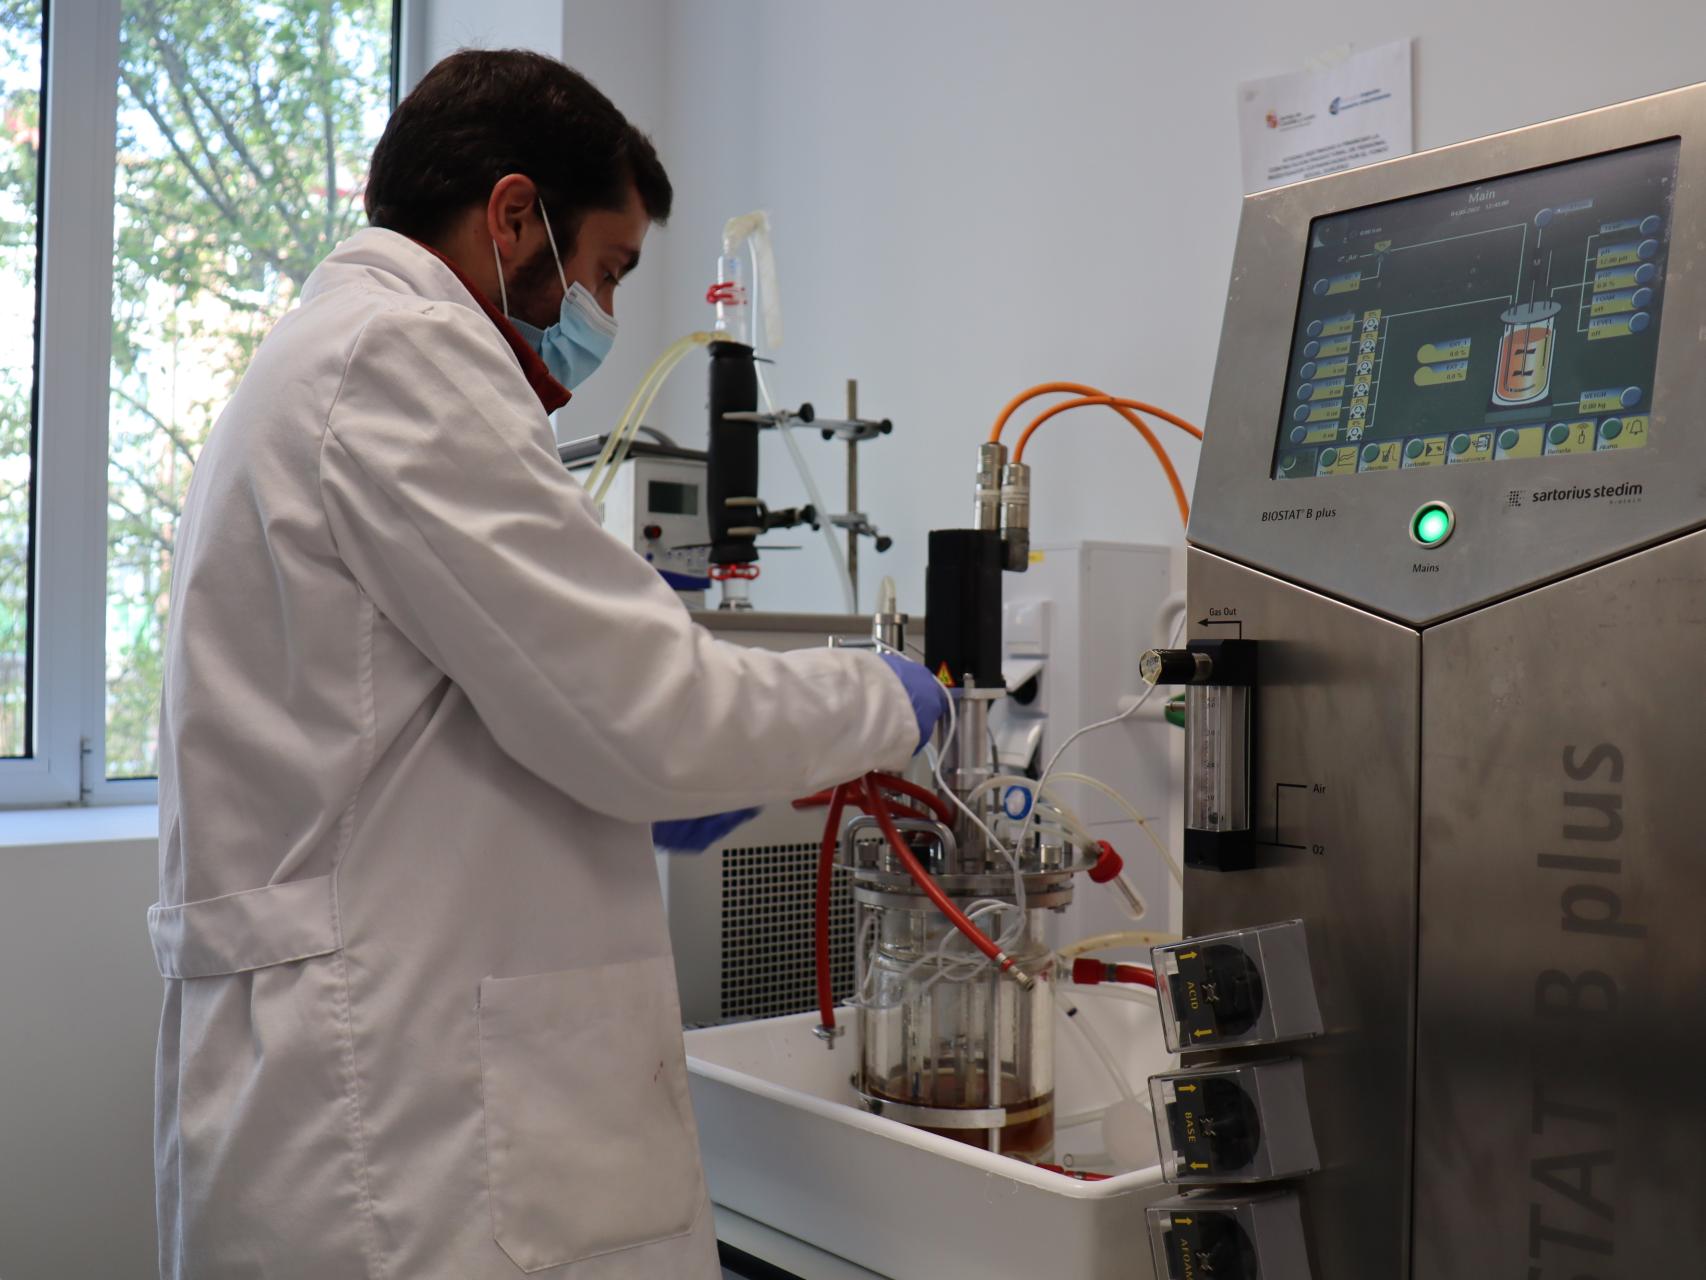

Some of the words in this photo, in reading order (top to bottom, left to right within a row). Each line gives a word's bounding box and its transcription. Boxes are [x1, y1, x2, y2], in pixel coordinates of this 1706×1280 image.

[1468, 190, 1496, 204] Main
[1532, 486, 1591, 502] sartorius
[1593, 482, 1643, 498] stedim
[1305, 508, 1313, 519] B
[1315, 507, 1337, 521] plus
[1412, 563, 1440, 573] Mains
[1209, 607, 1222, 616] Gas
[1223, 607, 1237, 616] Out
[1313, 783, 1326, 793] Air
[1537, 742, 1648, 938] plus
[1185, 981, 1199, 1010] ACID
[1535, 969, 1619, 1024] B
[1184, 1111, 1197, 1144] BASE
